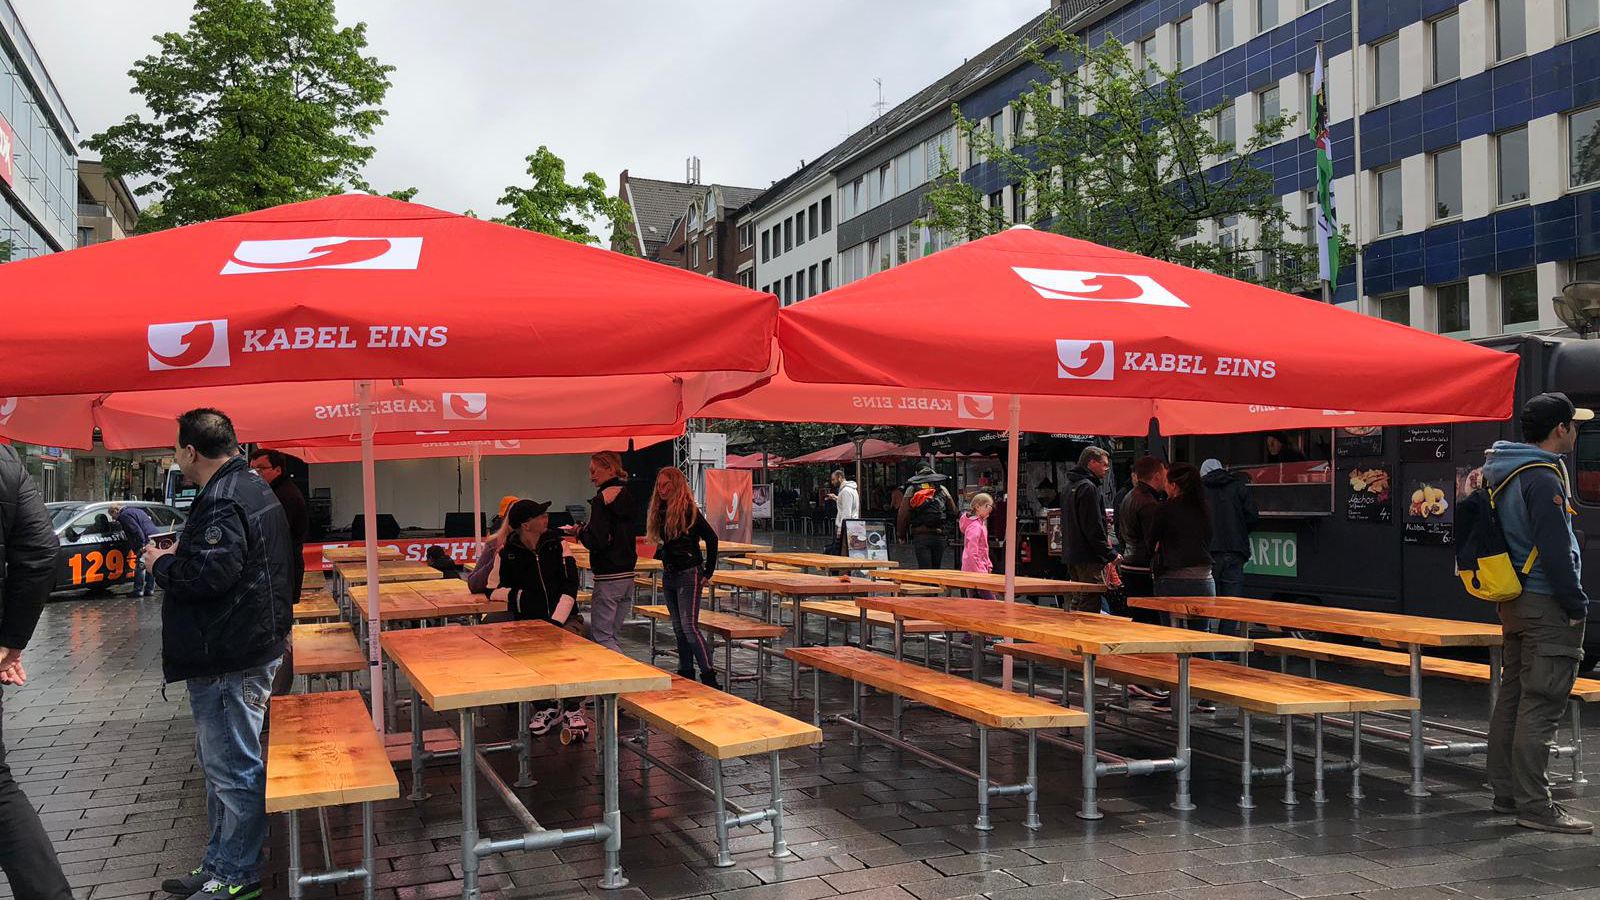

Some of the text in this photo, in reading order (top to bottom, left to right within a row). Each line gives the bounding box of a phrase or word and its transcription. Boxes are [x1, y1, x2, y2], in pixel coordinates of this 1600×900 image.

[242, 326, 448, 352] KABEL EINS
[1122, 351, 1276, 378] KABEL EINS
